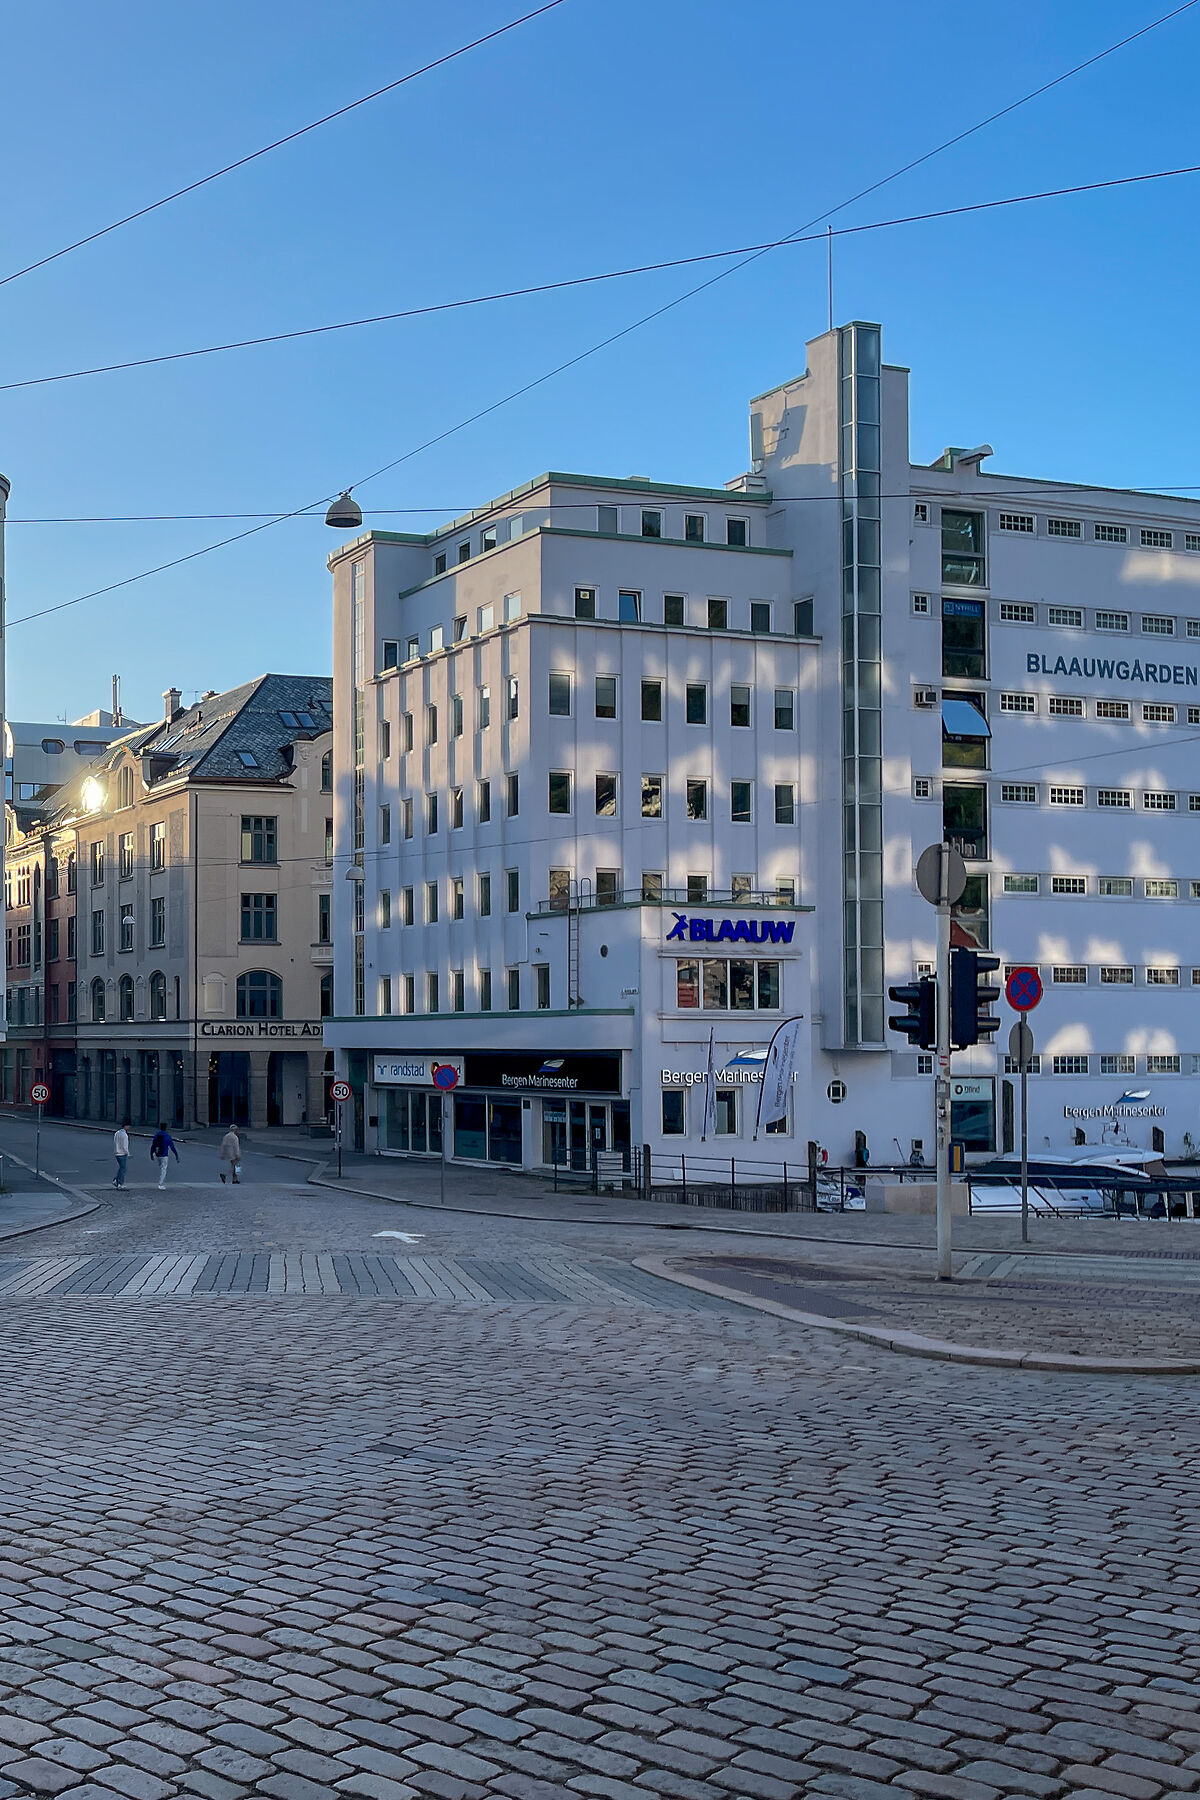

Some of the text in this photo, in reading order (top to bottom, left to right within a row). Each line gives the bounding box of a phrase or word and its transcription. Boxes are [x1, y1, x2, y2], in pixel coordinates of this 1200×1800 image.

[1026, 652, 1198, 686] BLAAUWGÅRDEN
[689, 918, 796, 943] BLAAUW
[390, 1061, 425, 1077] randstad
[502, 1073, 579, 1089] Bergen Marinesenter
[34, 1088, 47, 1098] 50
[334, 1086, 349, 1097] 50
